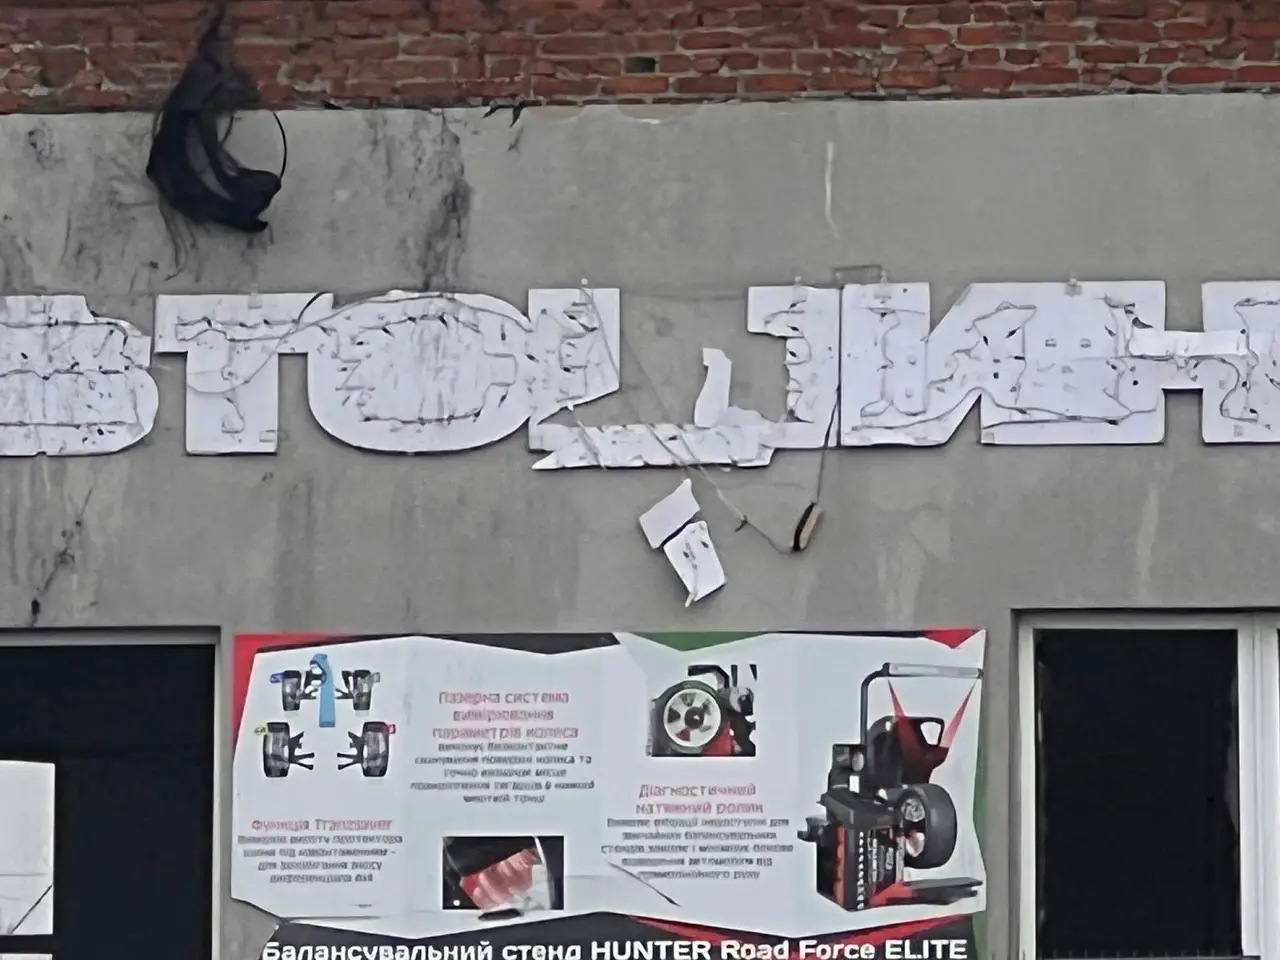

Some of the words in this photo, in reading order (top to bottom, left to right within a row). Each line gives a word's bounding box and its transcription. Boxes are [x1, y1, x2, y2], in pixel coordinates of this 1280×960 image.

[263, 941, 493, 960] Балансувальний
[502, 943, 581, 960] стенд
[592, 940, 711, 960] HUNTER
[721, 940, 789, 960] Road
[799, 940, 875, 960] Force
[885, 940, 967, 960] ELITE
